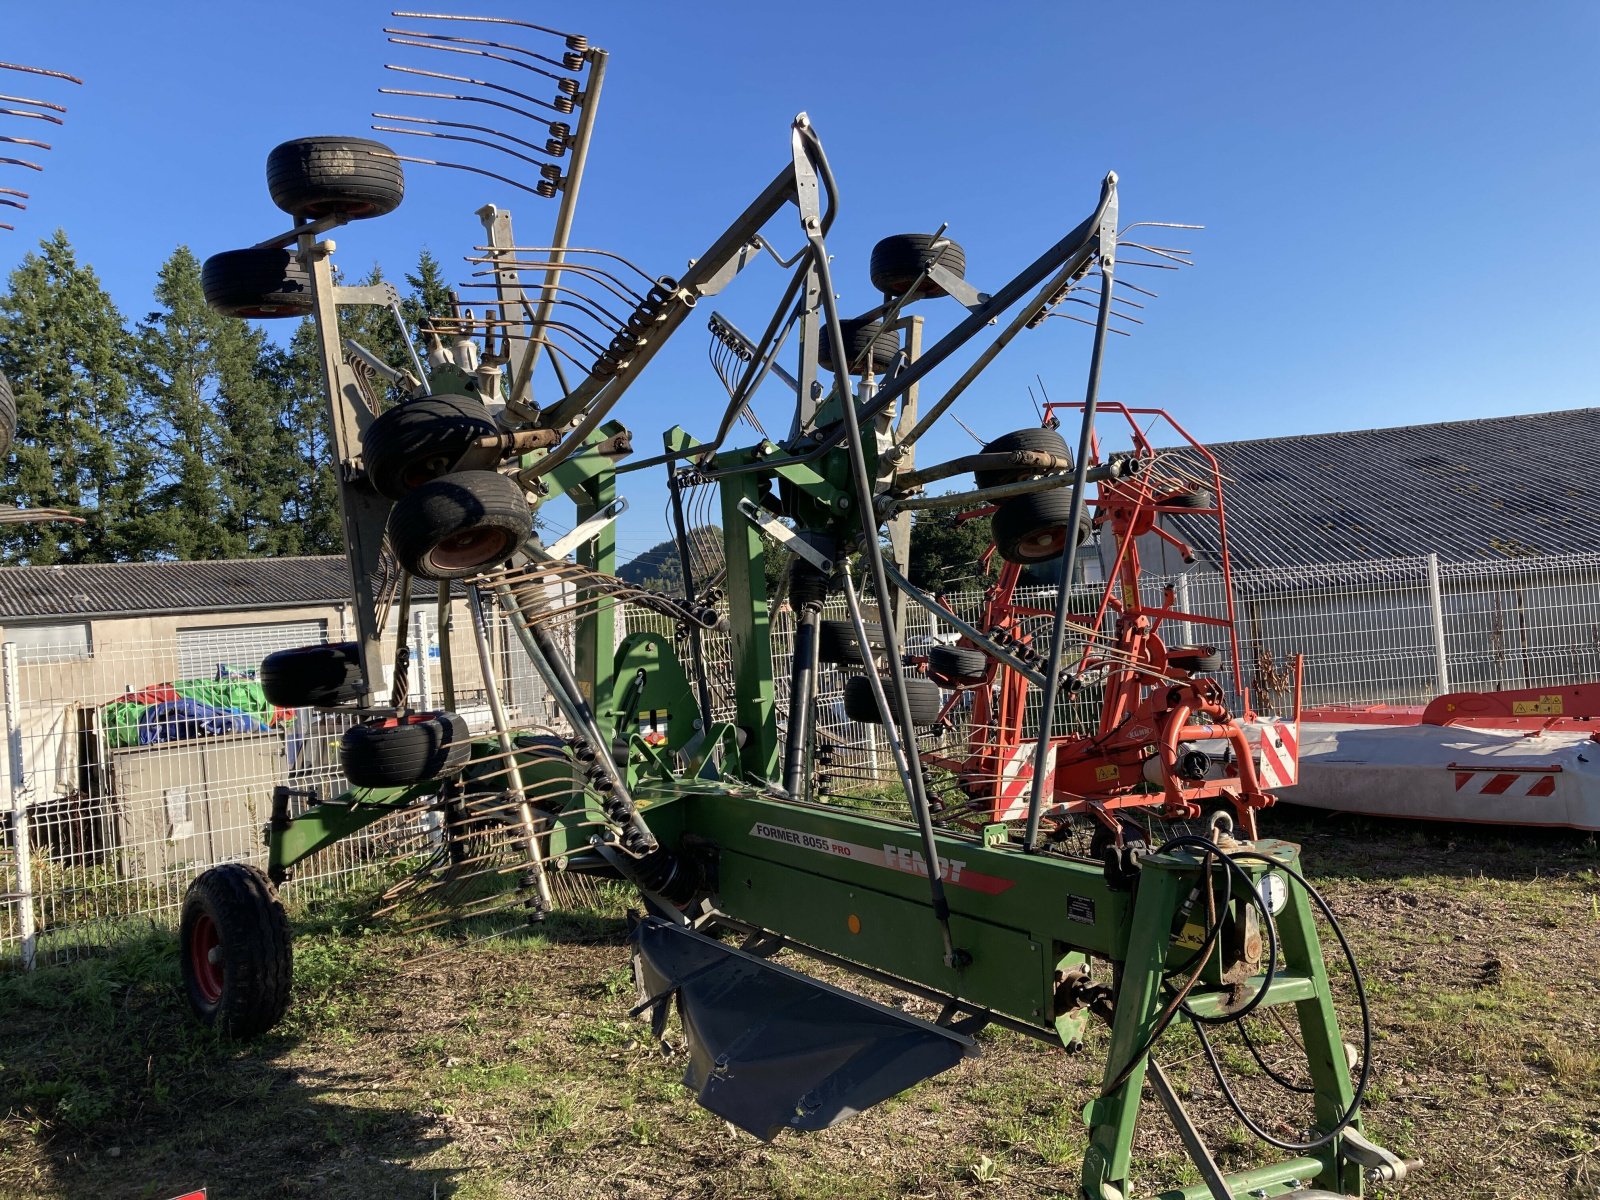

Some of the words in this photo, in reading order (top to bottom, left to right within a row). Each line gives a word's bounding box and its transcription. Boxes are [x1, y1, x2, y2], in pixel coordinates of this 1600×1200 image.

[756, 825, 801, 844] FORMER
[802, 835, 830, 851] 8055
[831, 844, 851, 856] PRO
